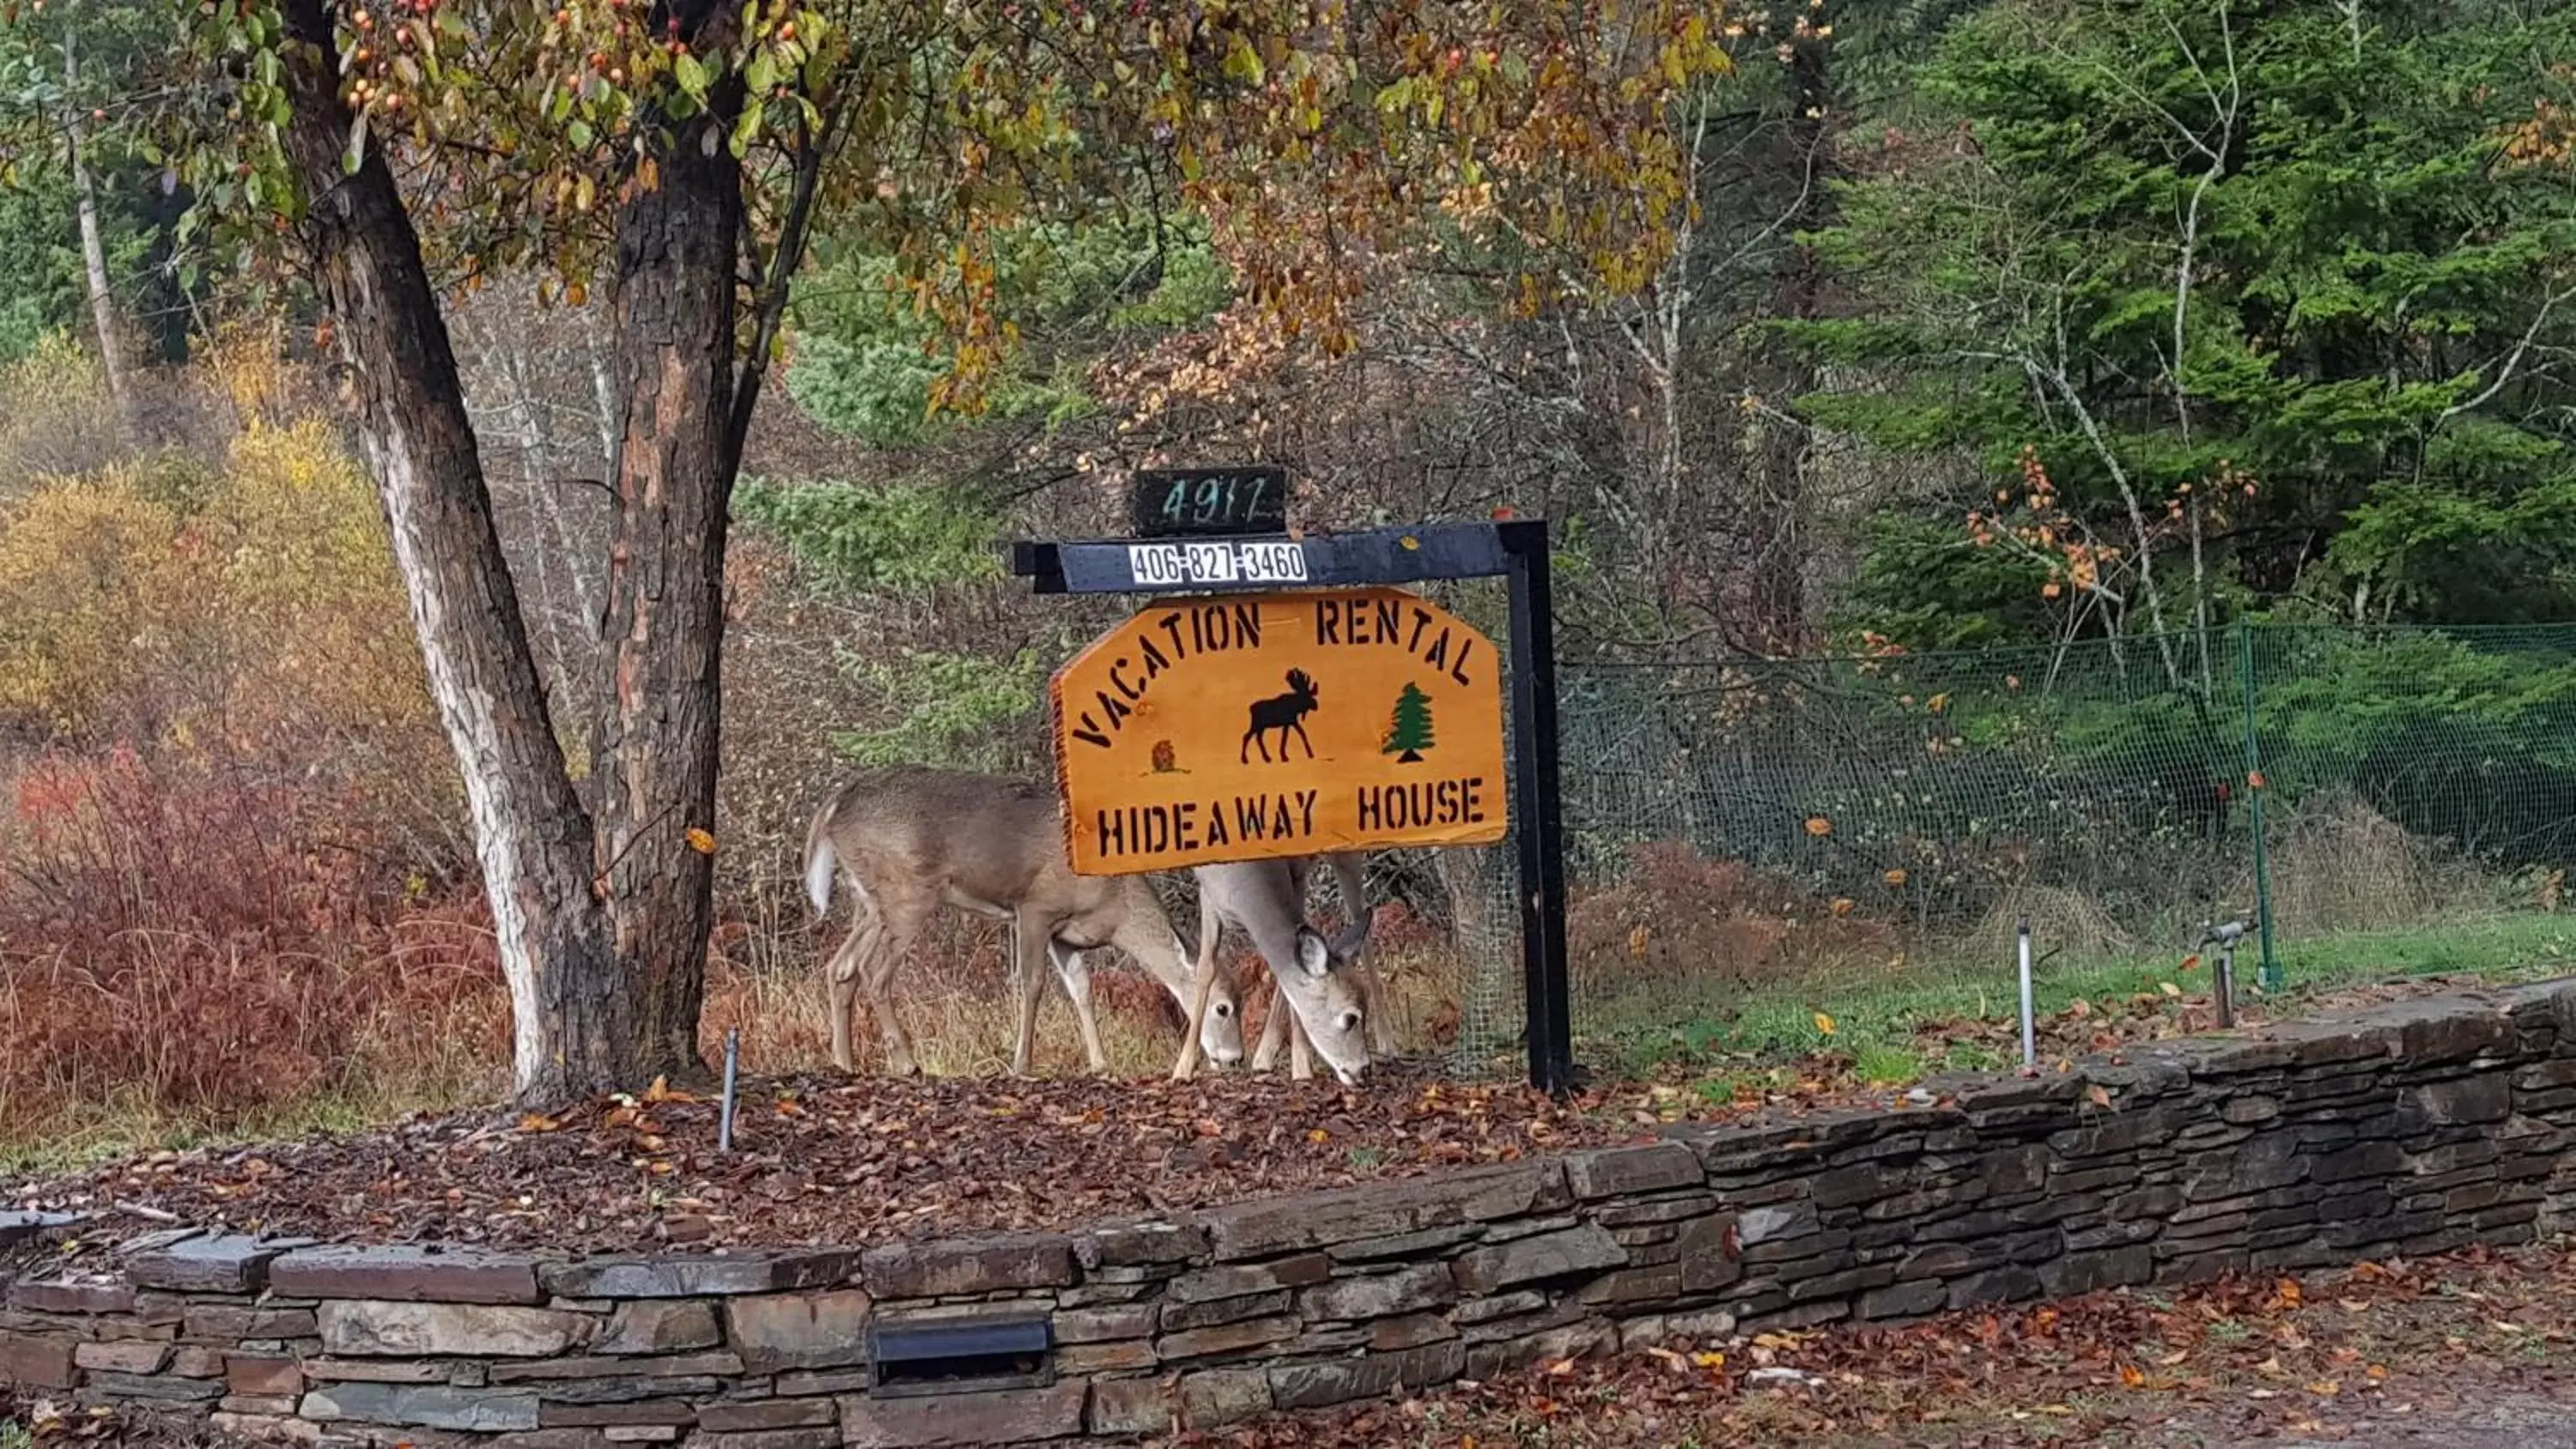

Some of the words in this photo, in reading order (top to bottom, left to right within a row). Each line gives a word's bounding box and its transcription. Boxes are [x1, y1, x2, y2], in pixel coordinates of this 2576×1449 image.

[1134, 544, 1304, 580] 406-827-3460
[1072, 603, 1261, 749] VACATION
[1316, 600, 1473, 686] RENTAL
[1098, 790, 1318, 858] HIDEAWAY
[1358, 778, 1485, 831] HOUSE
